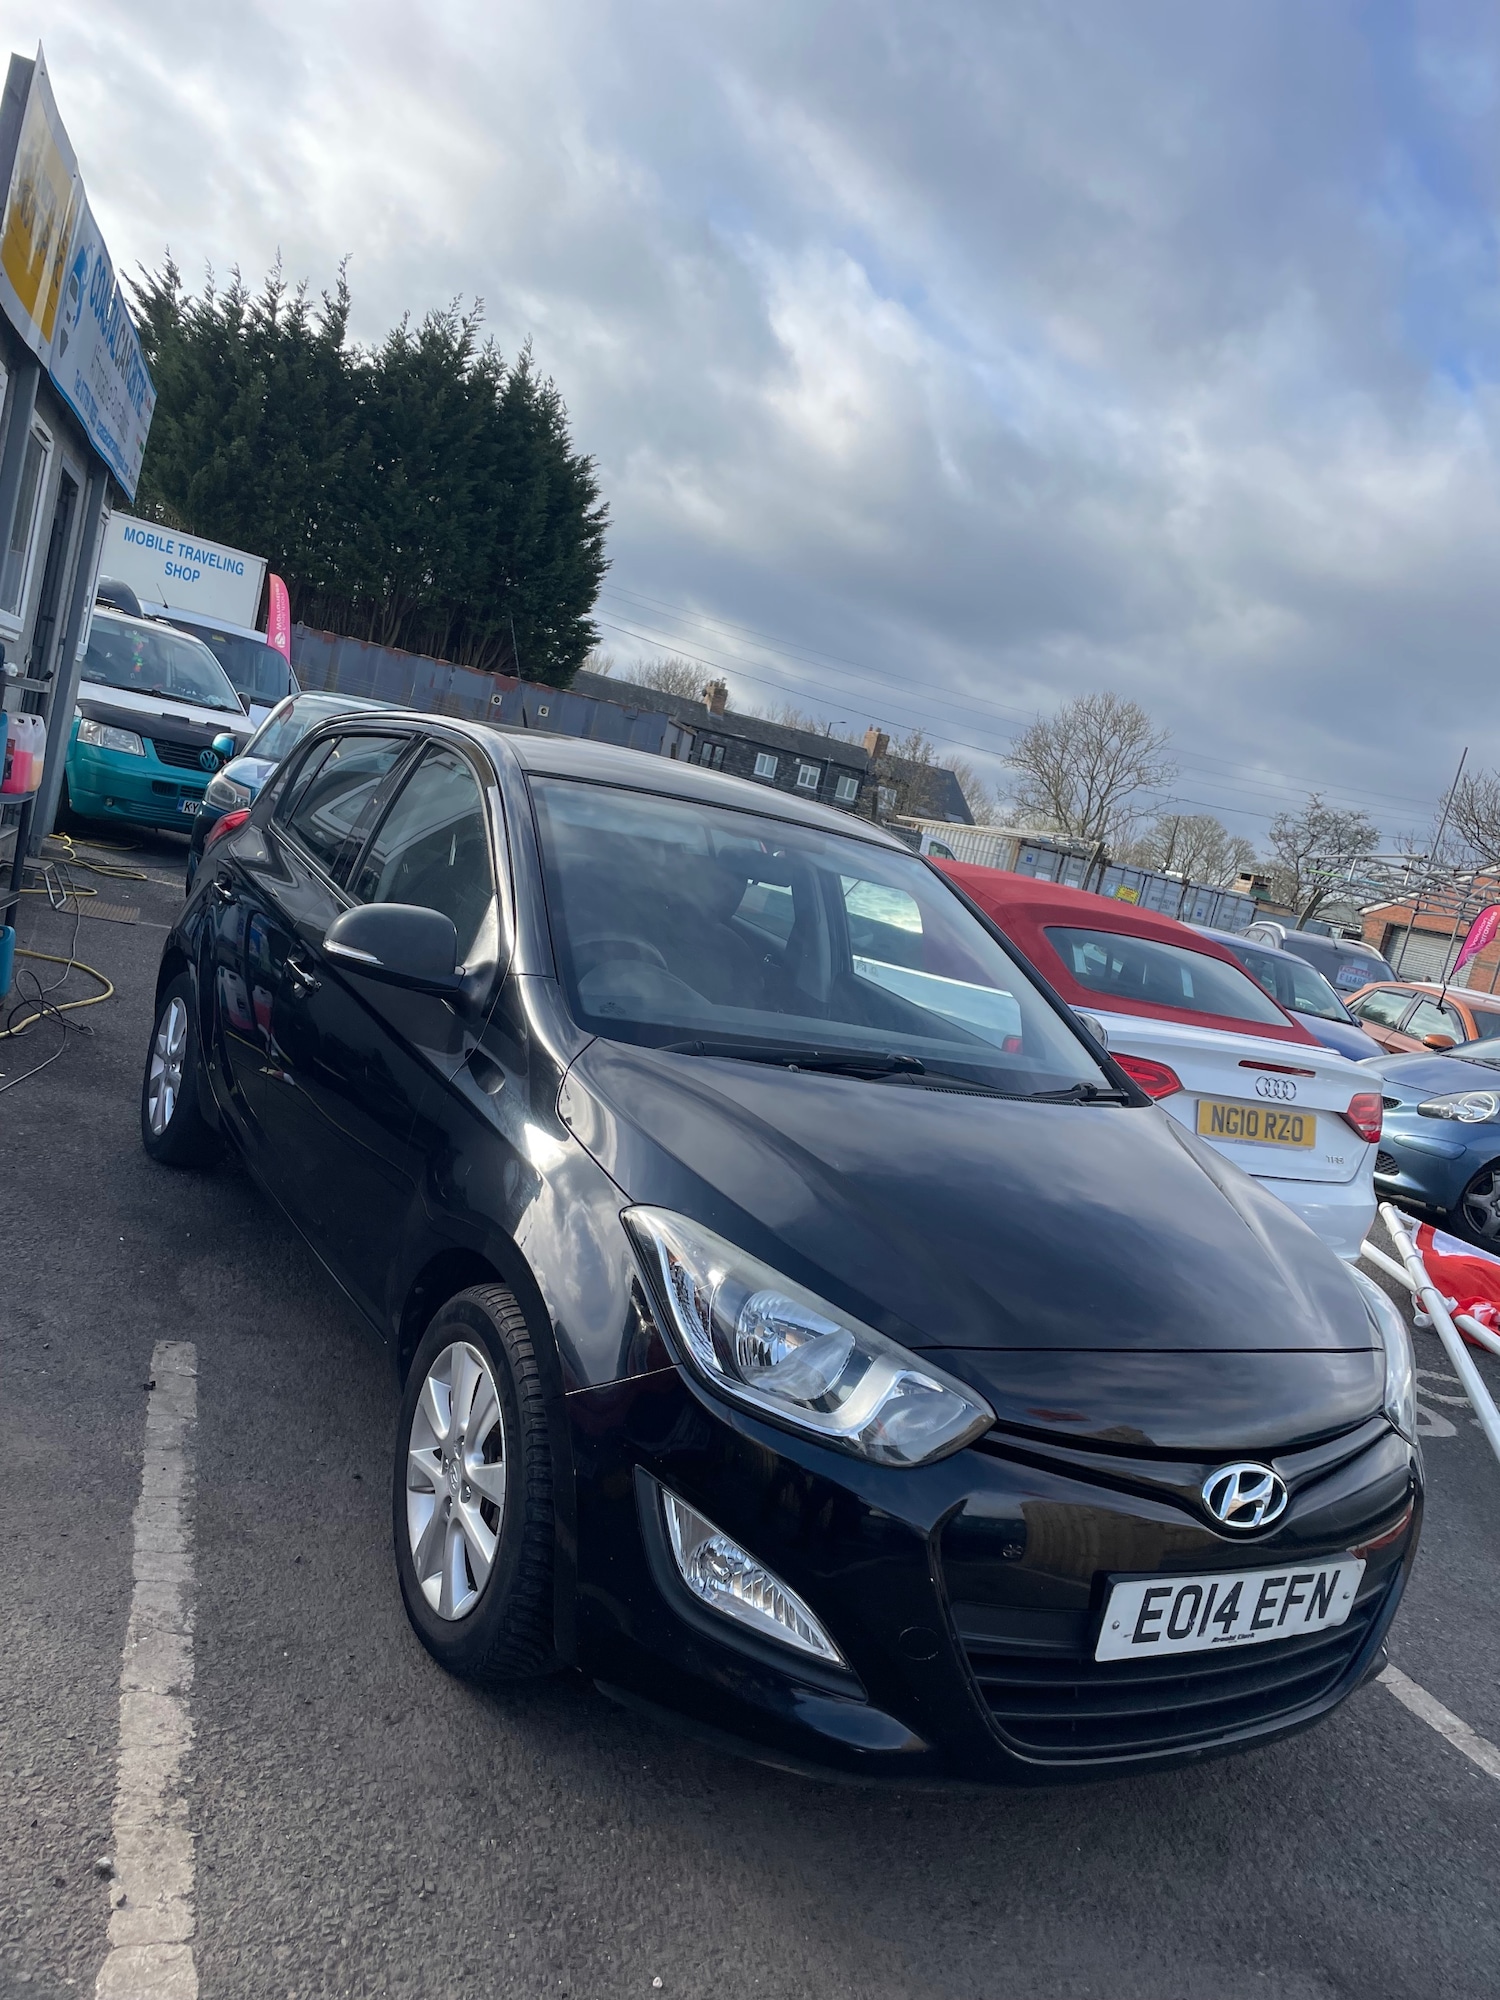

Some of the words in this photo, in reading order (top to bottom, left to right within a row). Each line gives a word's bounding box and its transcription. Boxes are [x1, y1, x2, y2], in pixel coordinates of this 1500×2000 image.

[124, 526, 175, 555] MOBILE
[178, 543, 244, 576] TRAVELING
[164, 562, 201, 582] SHOP
[1468, 916, 1489, 948] volution
[1479, 911, 1498, 945] arranties
[1211, 1105, 1259, 1137] NG10
[1131, 1581, 1244, 1644] EO14
[1249, 1570, 1341, 1631] EFN
